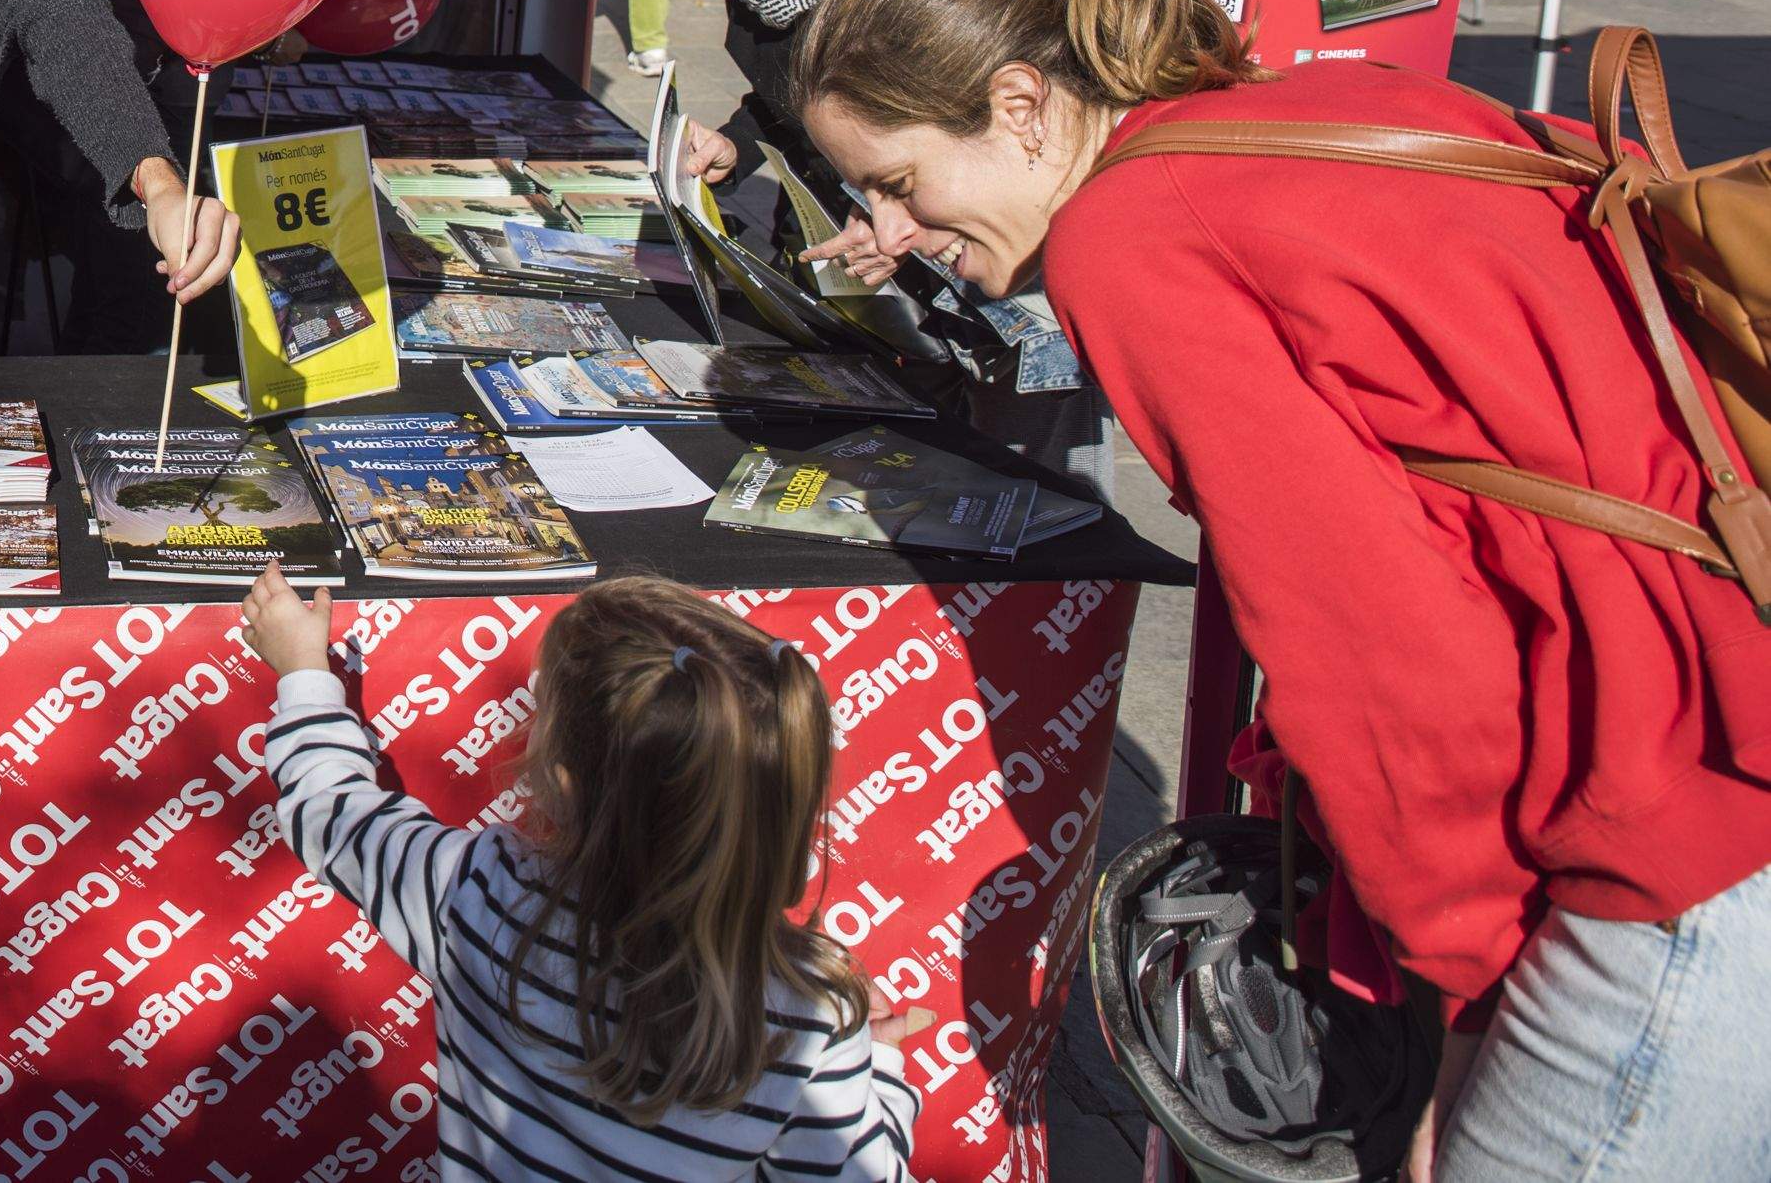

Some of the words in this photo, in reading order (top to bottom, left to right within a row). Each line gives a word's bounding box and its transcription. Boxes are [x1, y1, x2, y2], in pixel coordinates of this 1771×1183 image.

[1317, 48, 1367, 60] CINEMES
[258, 143, 326, 163] MónSantCugat
[266, 173, 285, 189] Per
[288, 169, 327, 186] només
[273, 187, 331, 232] 8€
[96, 431, 242, 443] MónSntCugat
[315, 418, 459, 432] MónSantCugat
[331, 437, 479, 450] MónSantCugat
[348, 458, 501, 472] MónSantCugat
[157, 549, 202, 558] EMMA
[165, 524, 262, 536] ARBRES
[166, 538, 184, 546] DE
[184, 538, 224, 546] SANT
[224, 538, 269, 547] CUGAT
[412, 507, 448, 516] SANT
[100, 663, 229, 779] Cugat
[918, 676, 1019, 773] TOT
[117, 778, 224, 869] Sant
[820, 752, 927, 844] Sant
[916, 752, 1044, 863] Cugat
[103, 901, 205, 986] TOT
[928, 867, 1035, 960] Sant
[10, 970, 114, 1055] Sant
[108, 963, 232, 1068] Cugat
[217, 994, 316, 1084] TOT
[912, 1001, 1012, 1093] TOT
[125, 1067, 227, 1156] Sant
[261, 1030, 383, 1138] Cugat
